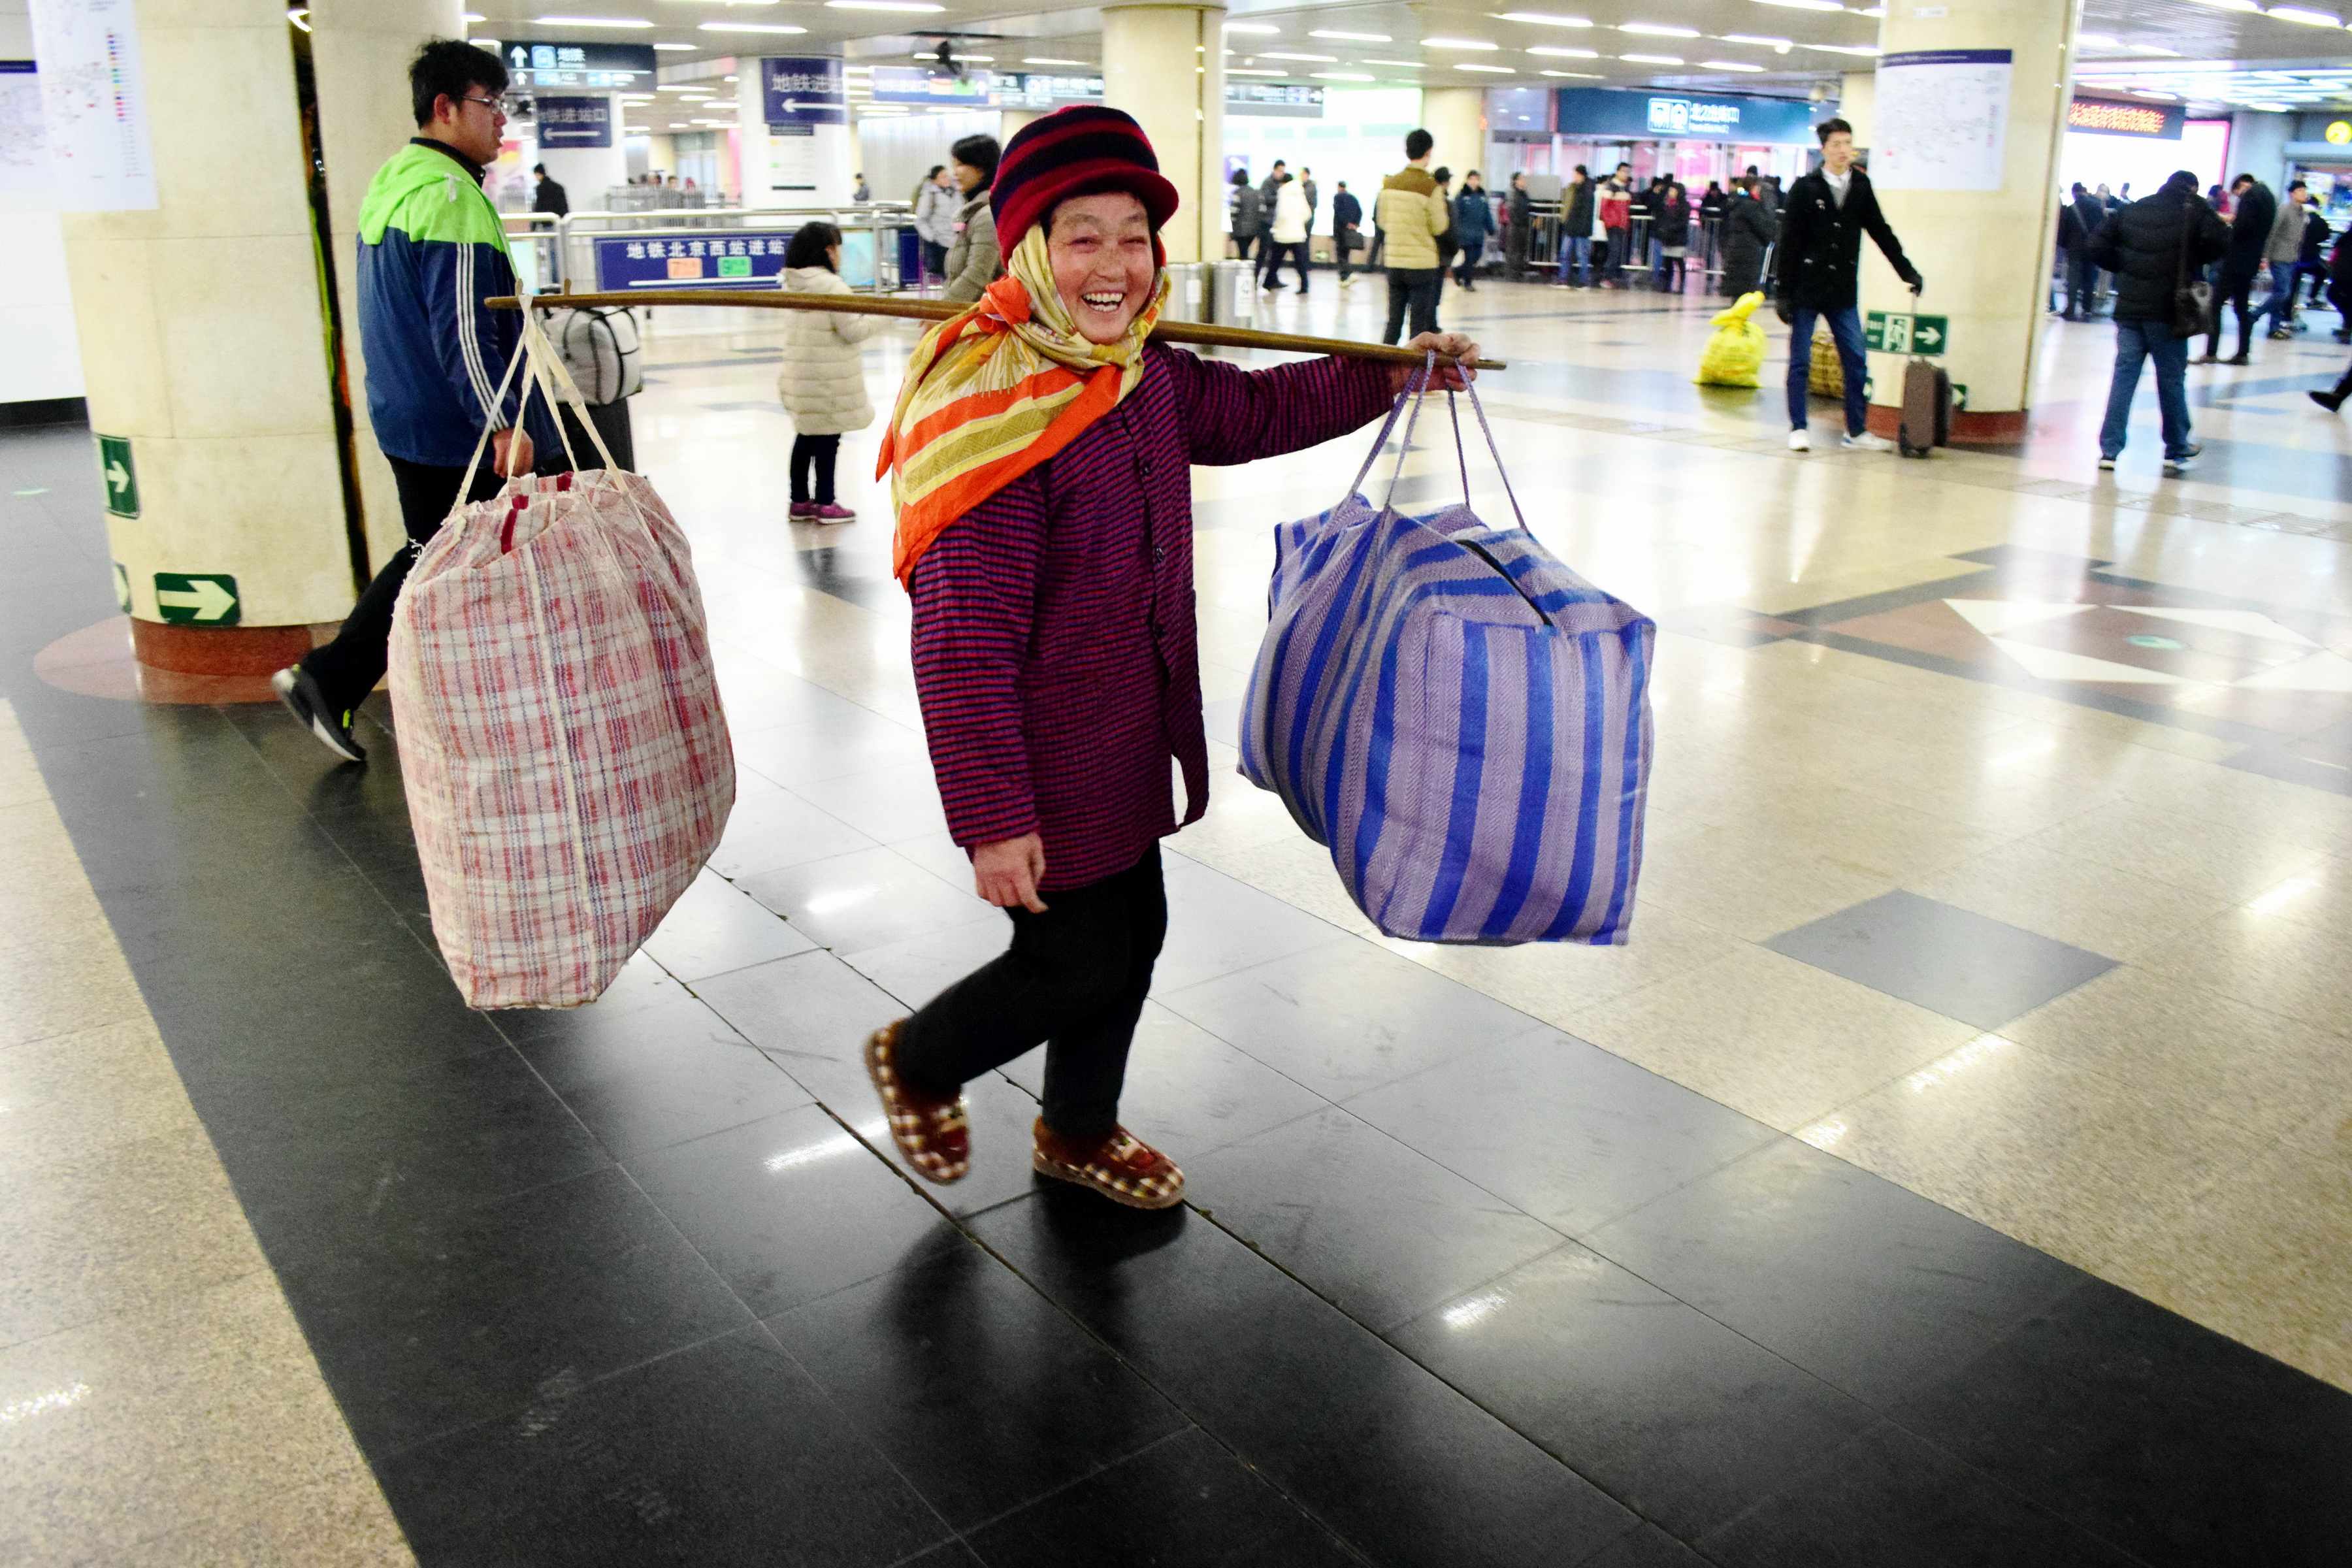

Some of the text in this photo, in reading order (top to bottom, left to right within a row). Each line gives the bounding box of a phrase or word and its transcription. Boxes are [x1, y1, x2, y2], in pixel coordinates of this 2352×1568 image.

[626, 239, 785, 259] 地铁北京西站进站
